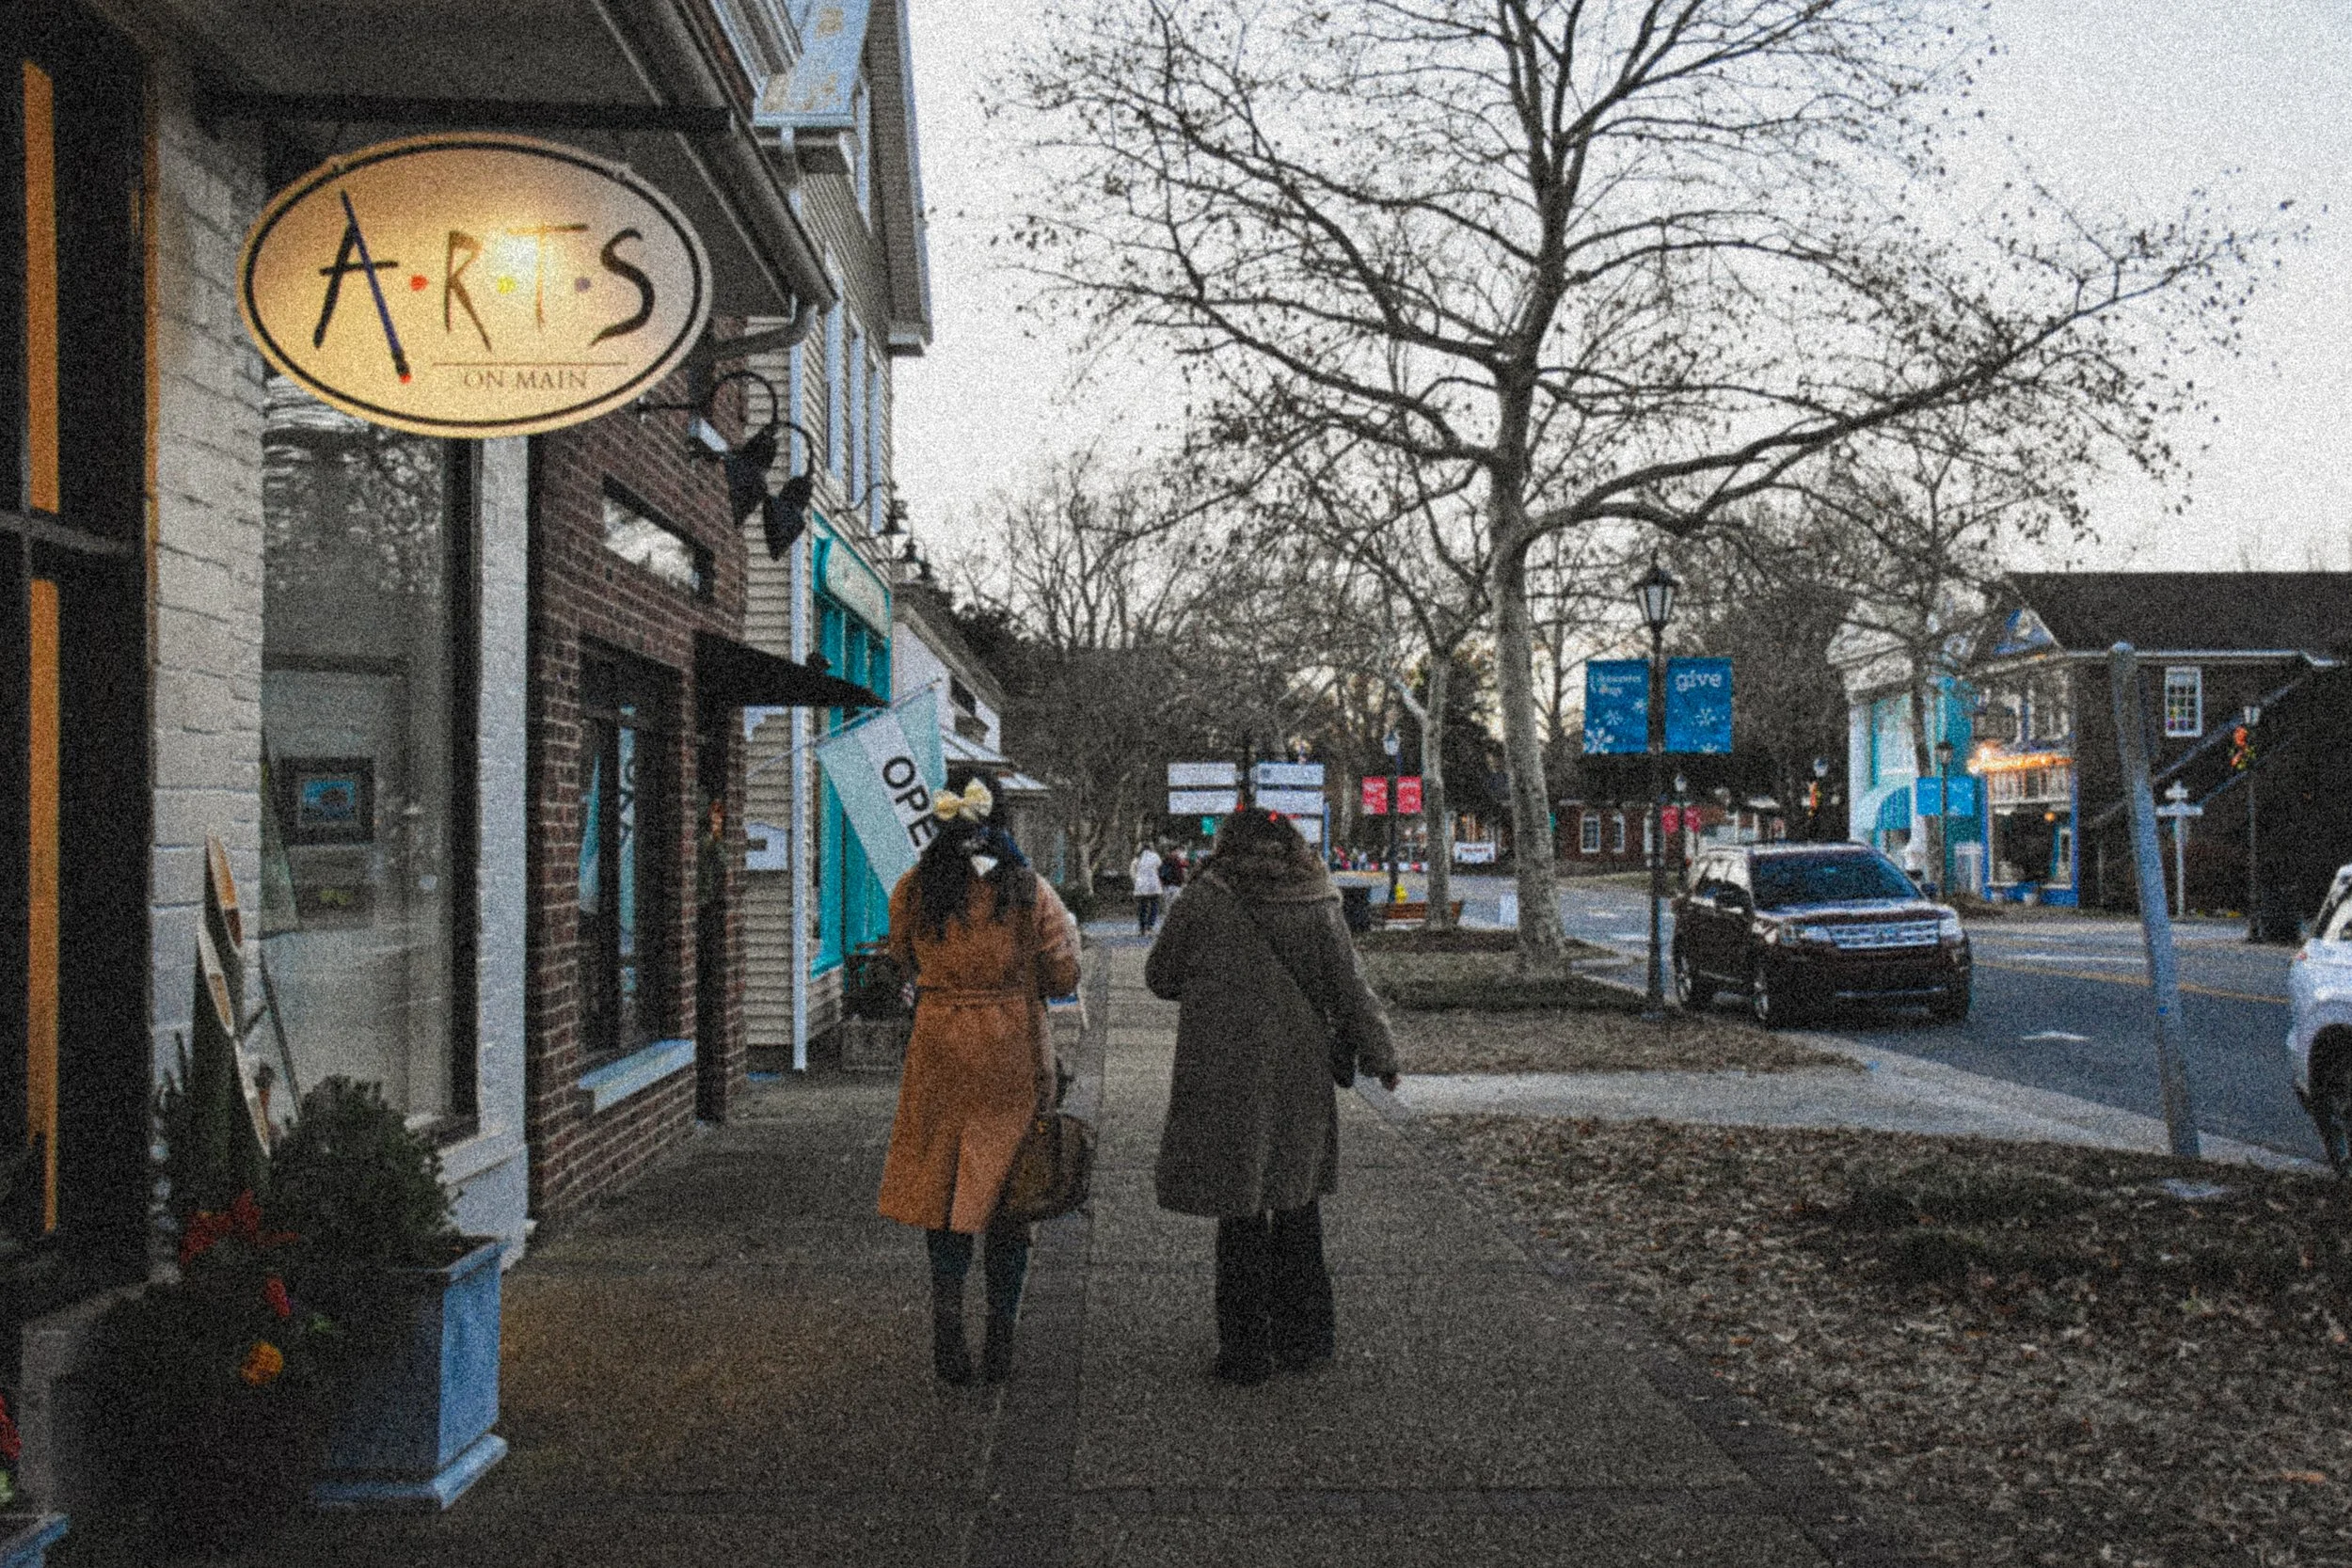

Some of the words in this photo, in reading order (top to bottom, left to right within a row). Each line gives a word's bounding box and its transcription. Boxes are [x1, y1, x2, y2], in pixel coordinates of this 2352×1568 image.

[464, 371, 503, 388] ON
[516, 371, 587, 389] MAIN
[1675, 669, 1723, 692] give
[882, 755, 940, 847] OPE
